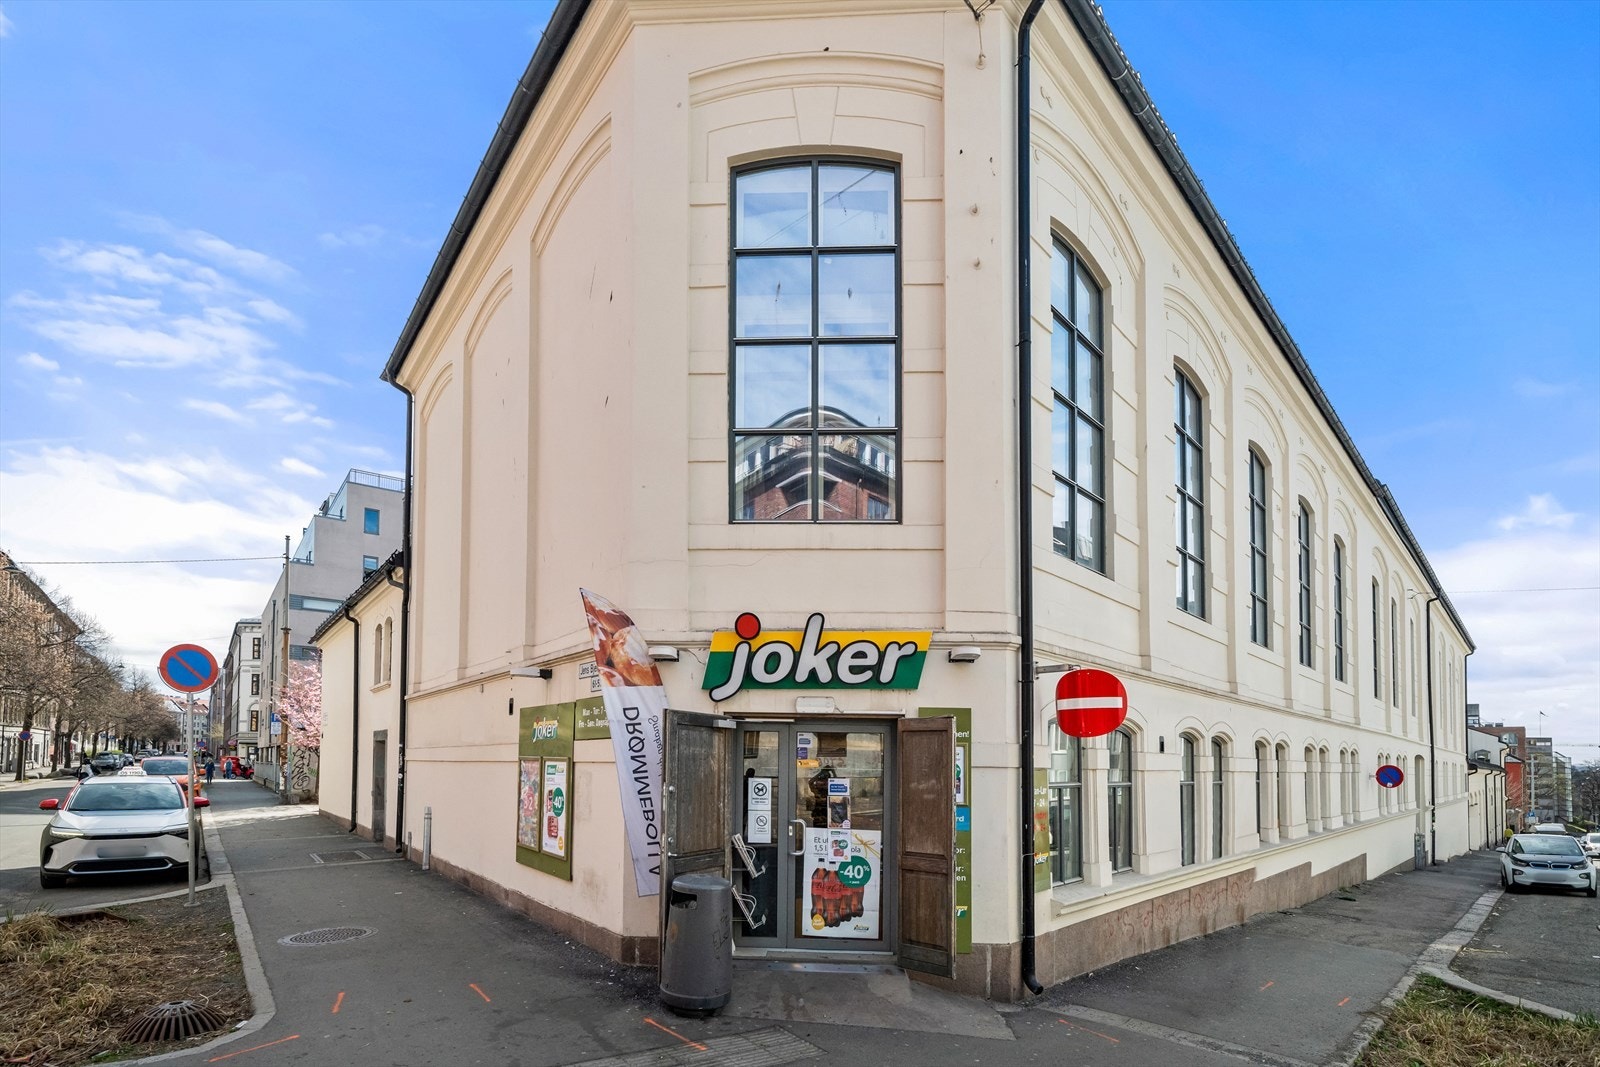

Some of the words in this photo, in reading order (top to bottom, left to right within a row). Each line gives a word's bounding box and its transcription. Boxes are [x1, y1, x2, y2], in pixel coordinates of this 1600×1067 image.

[709, 612, 918, 702] joker
[580, 666, 589, 675] Jens
[532, 715, 559, 743] joker
[840, 864, 870, 879] -40%
